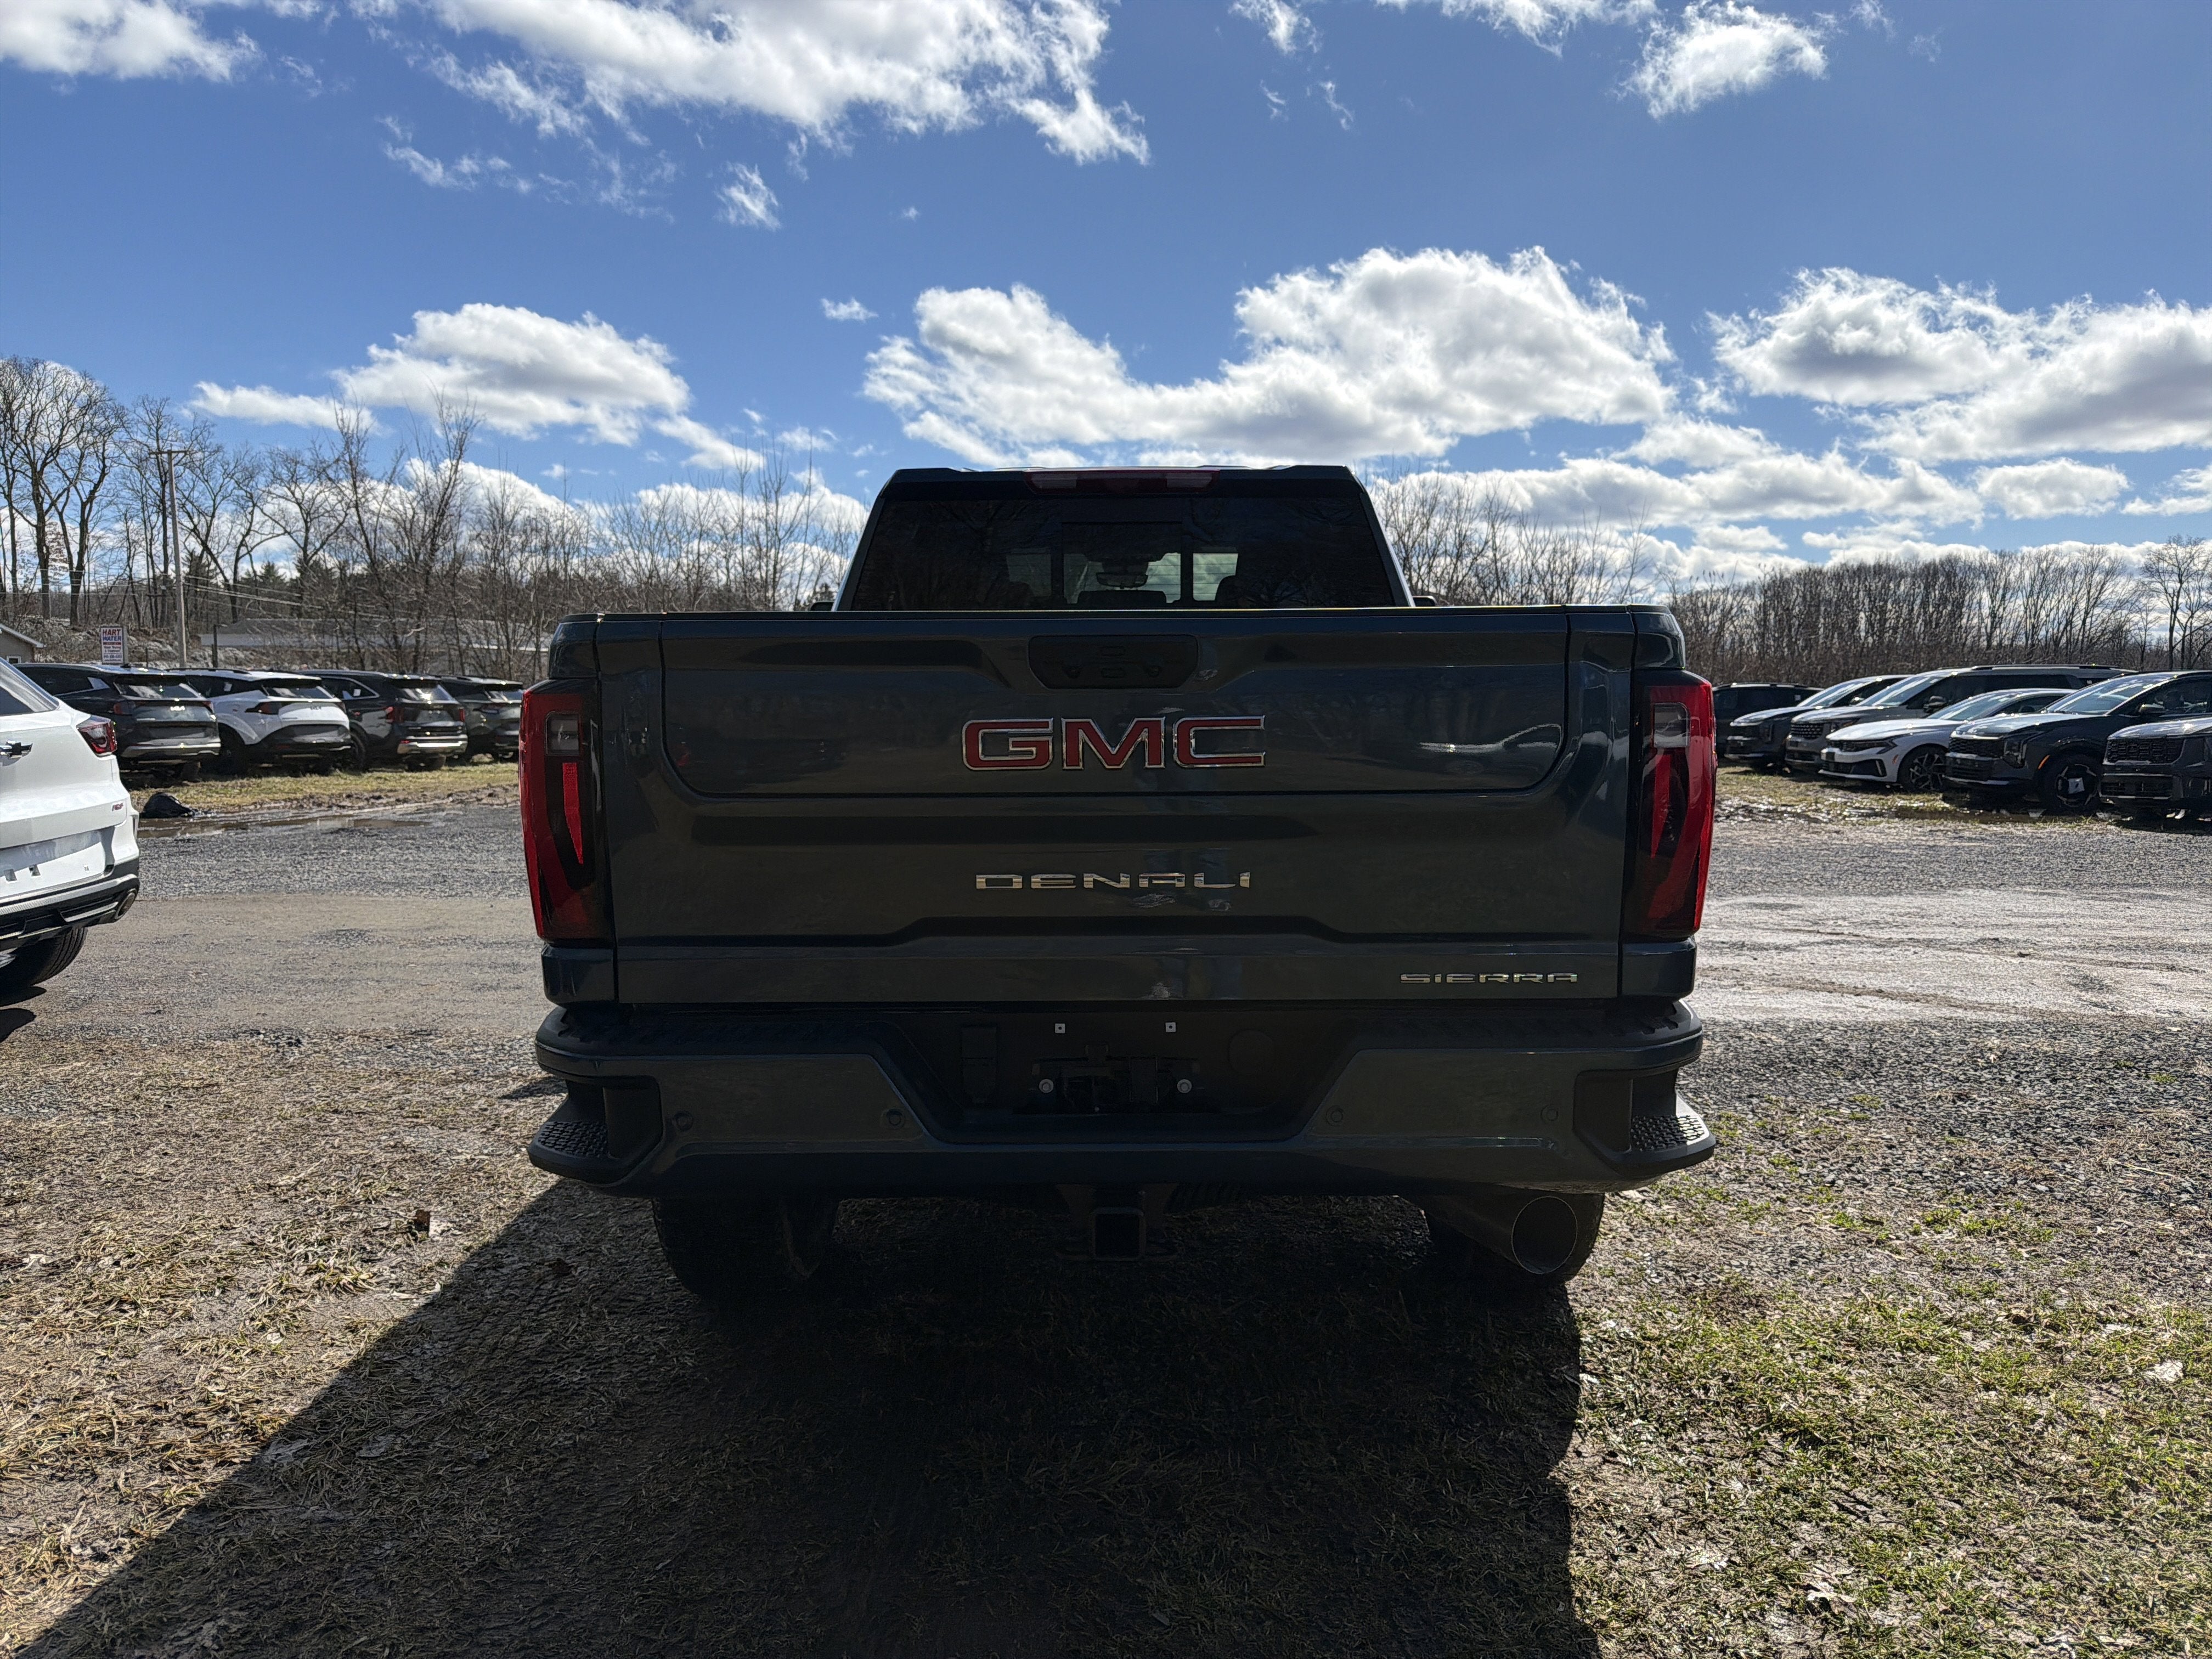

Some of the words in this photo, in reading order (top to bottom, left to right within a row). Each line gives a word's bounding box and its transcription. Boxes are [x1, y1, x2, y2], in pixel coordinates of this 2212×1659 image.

[962, 715, 1266, 770] GMC
[975, 872, 1250, 889] DENALI
[1400, 973, 1577, 984] SIERRA
